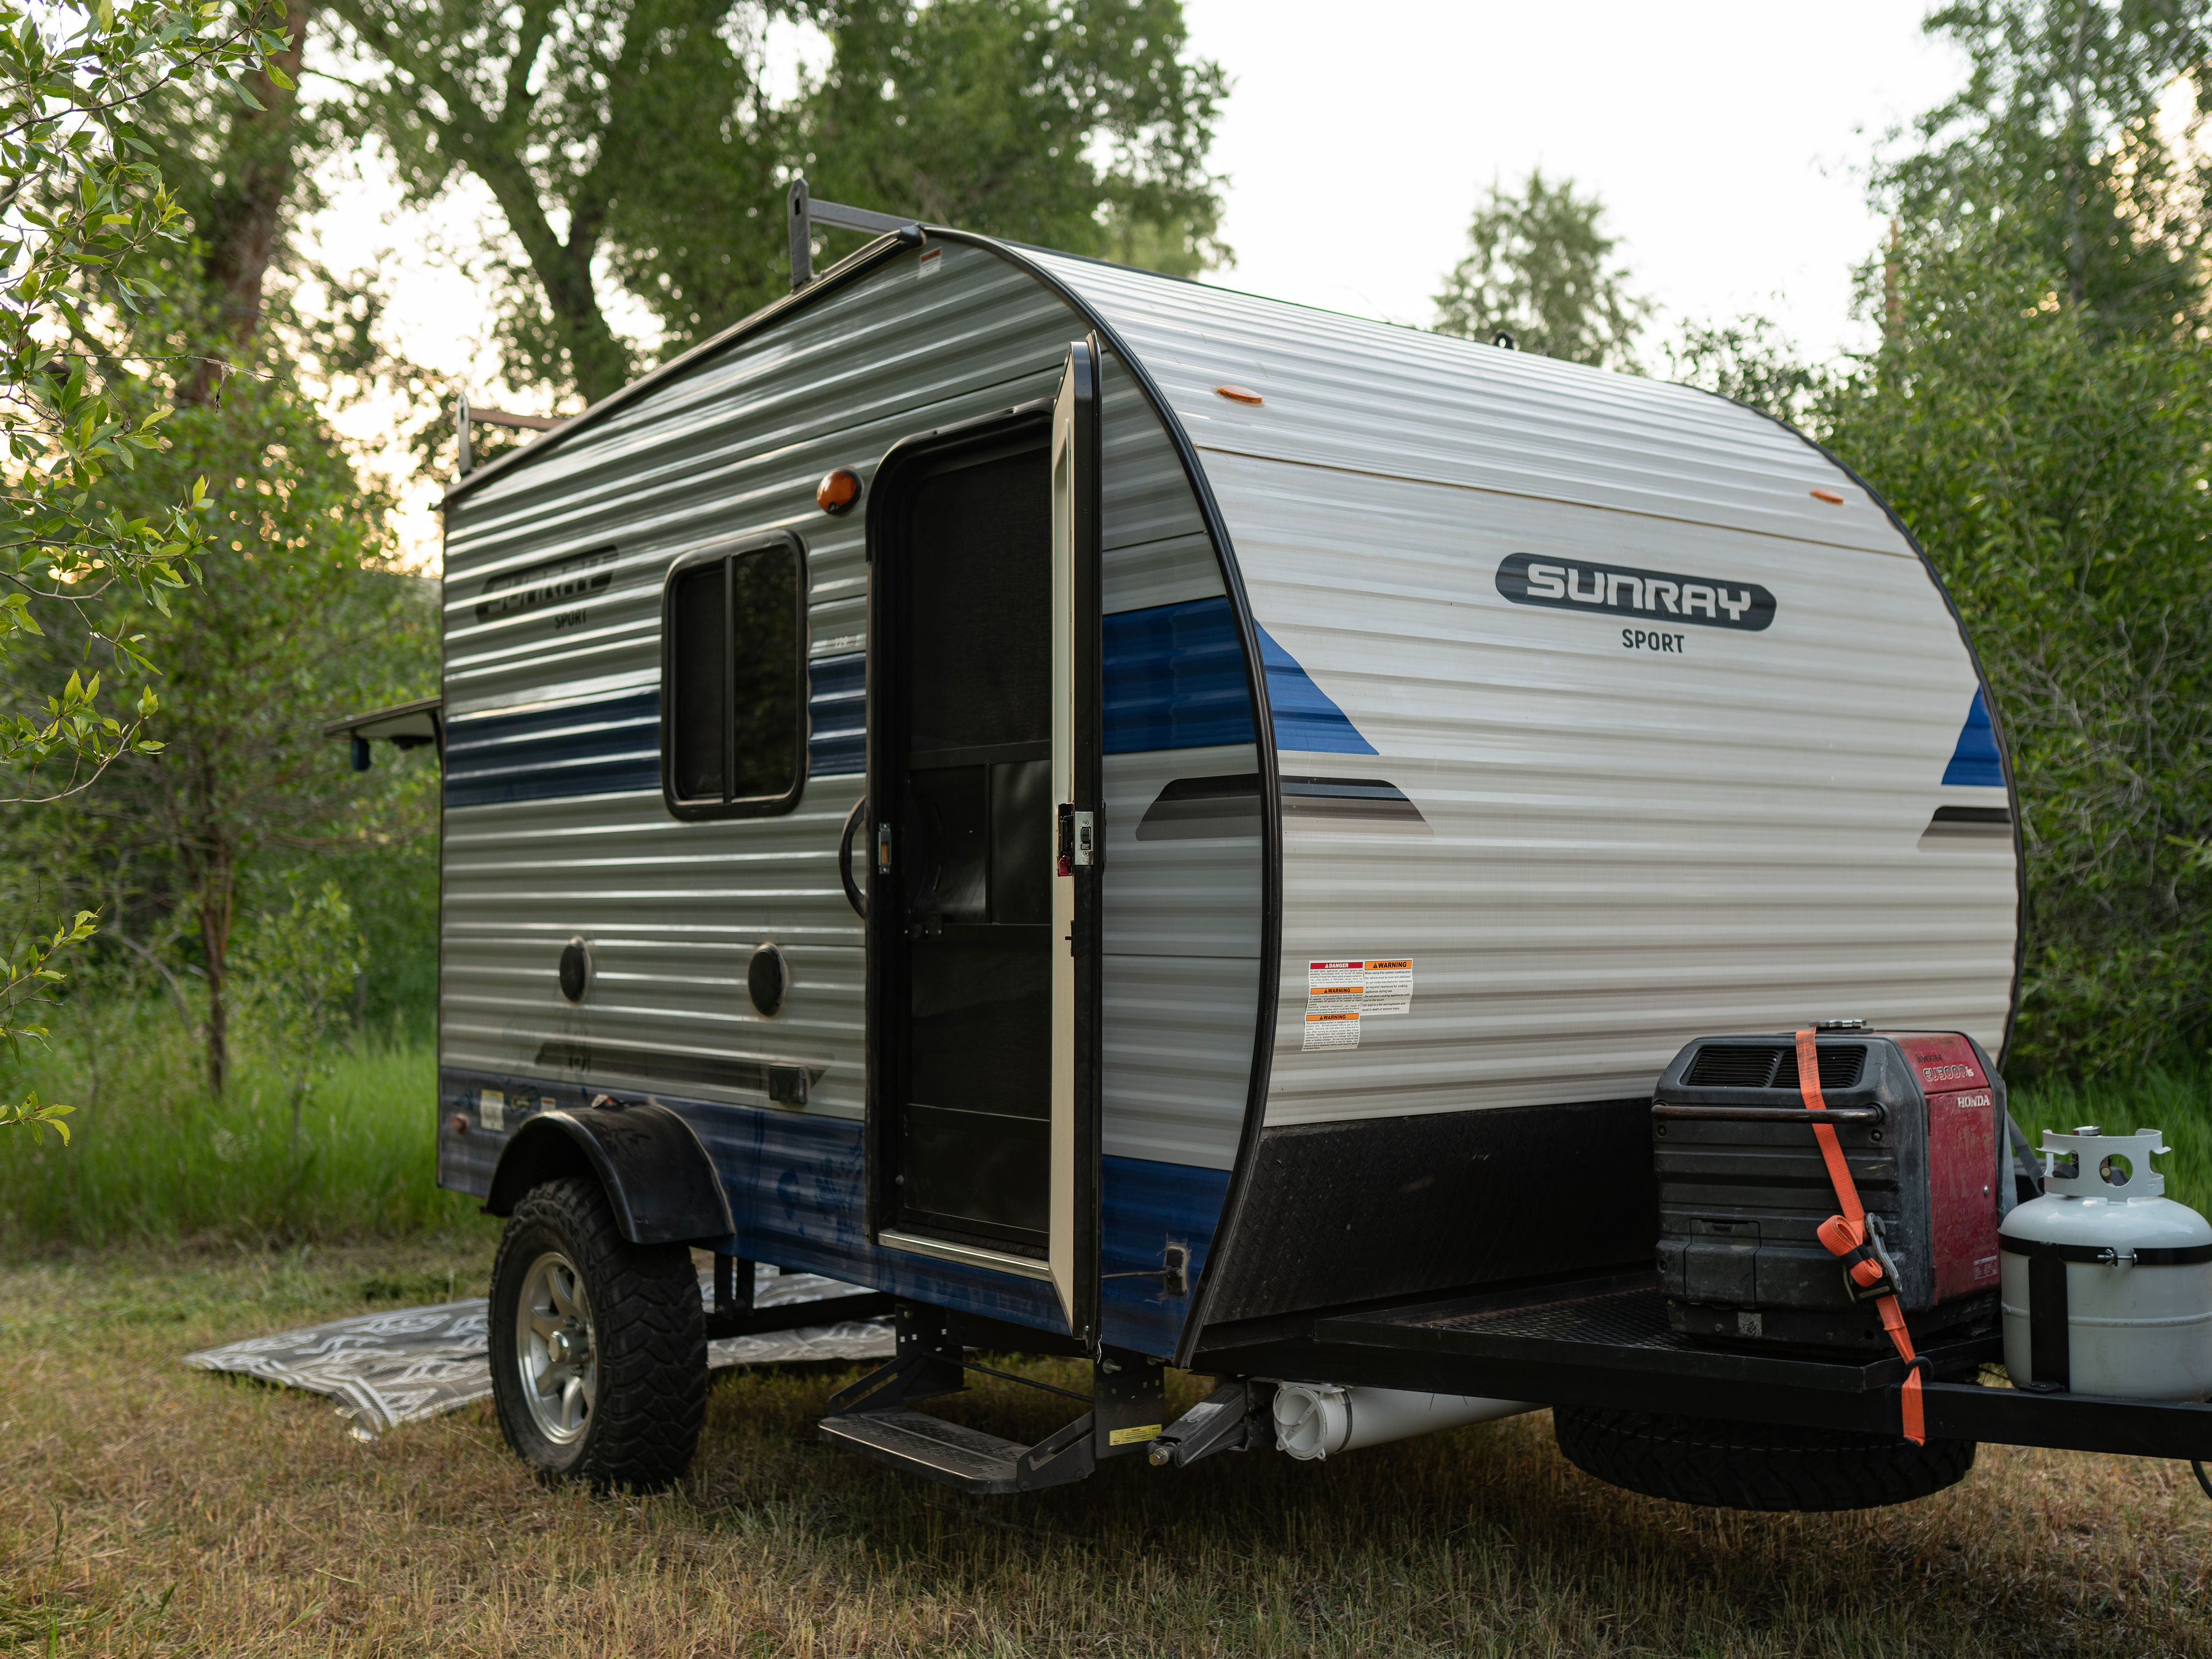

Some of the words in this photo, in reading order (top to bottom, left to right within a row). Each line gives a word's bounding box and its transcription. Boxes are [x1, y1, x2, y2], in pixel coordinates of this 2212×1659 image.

[1527, 563, 1751, 621] SUNRAY
[555, 610, 587, 630] SPORT
[1622, 629, 1685, 653] SPORT
[1957, 1095, 1991, 1108] HONDA
